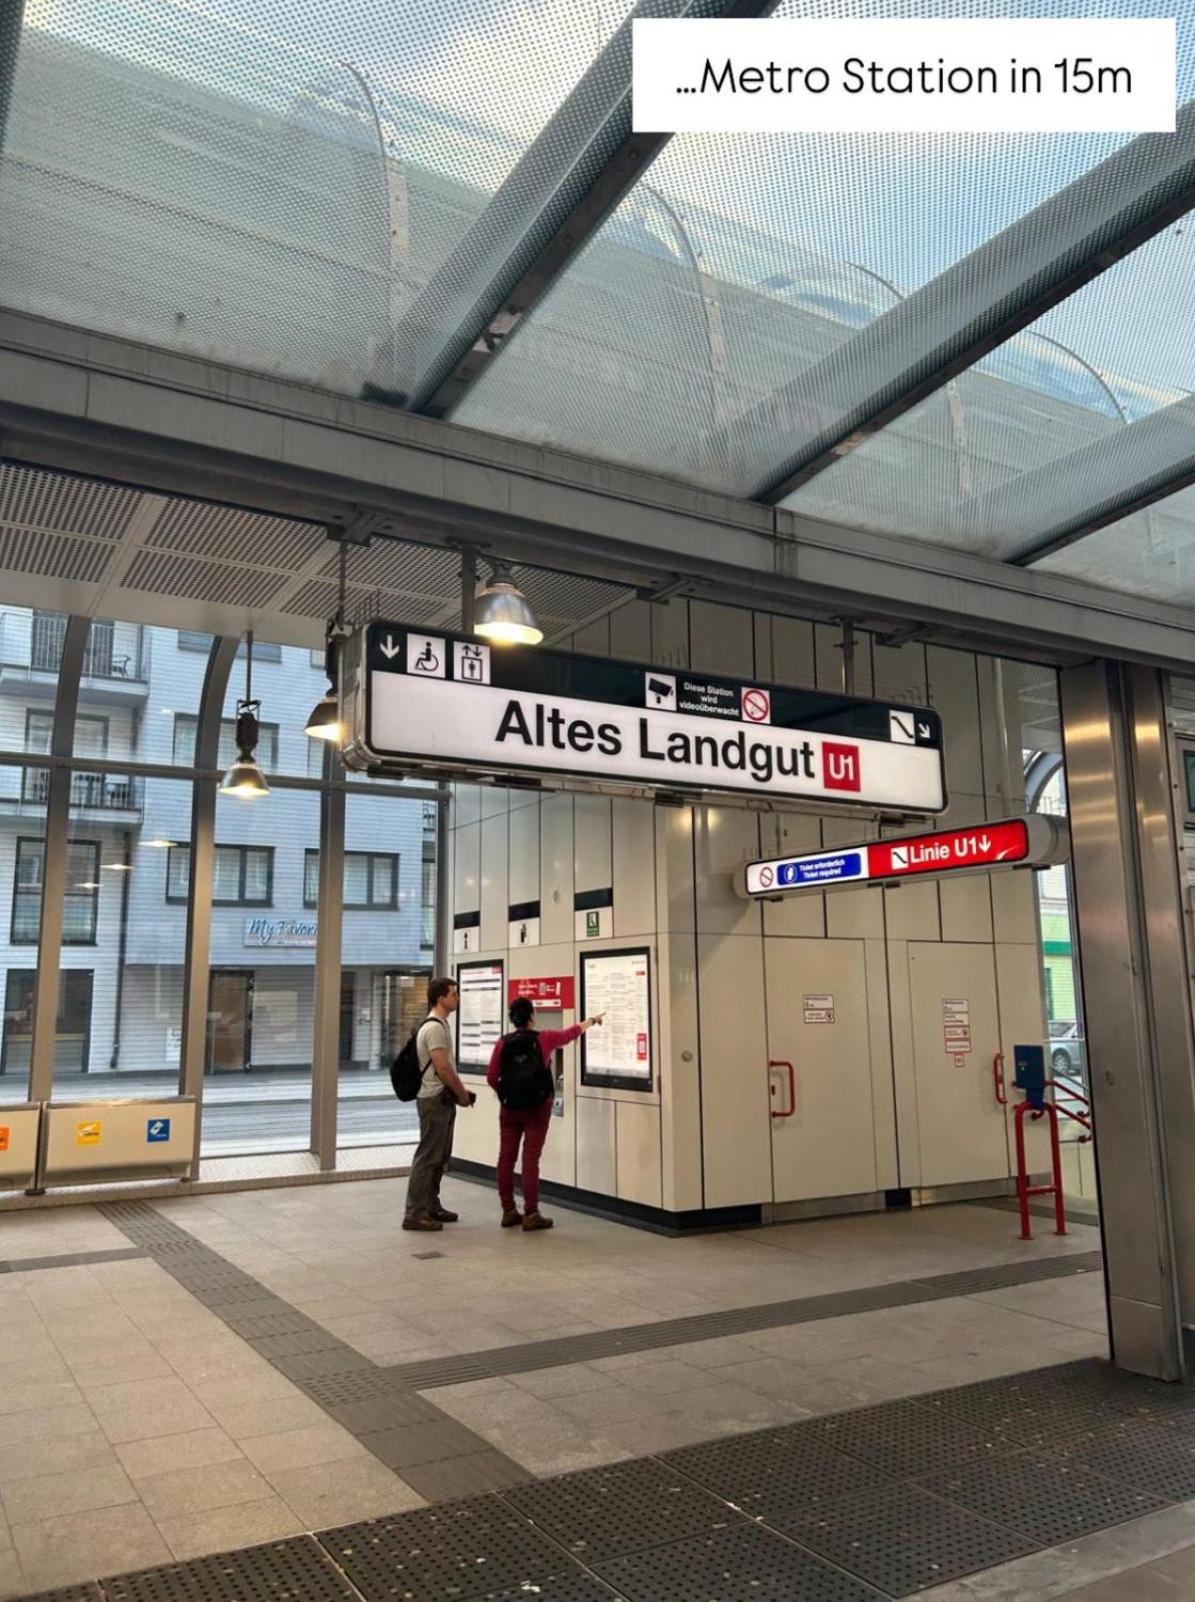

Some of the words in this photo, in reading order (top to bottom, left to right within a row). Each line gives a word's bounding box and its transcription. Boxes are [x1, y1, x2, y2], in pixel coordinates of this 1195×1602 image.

[683, 682, 706, 693] Diese
[707, 685, 734, 697] Station
[701, 695, 718, 704] wird
[679, 701, 740, 716] videoüberwacht
[495, 699, 622, 756] Altes
[639, 717, 815, 783] Landgut
[827, 755, 855, 781] U1
[910, 842, 950, 864] Linie
[954, 836, 977, 857] U1
[249, 919, 274, 945] My
